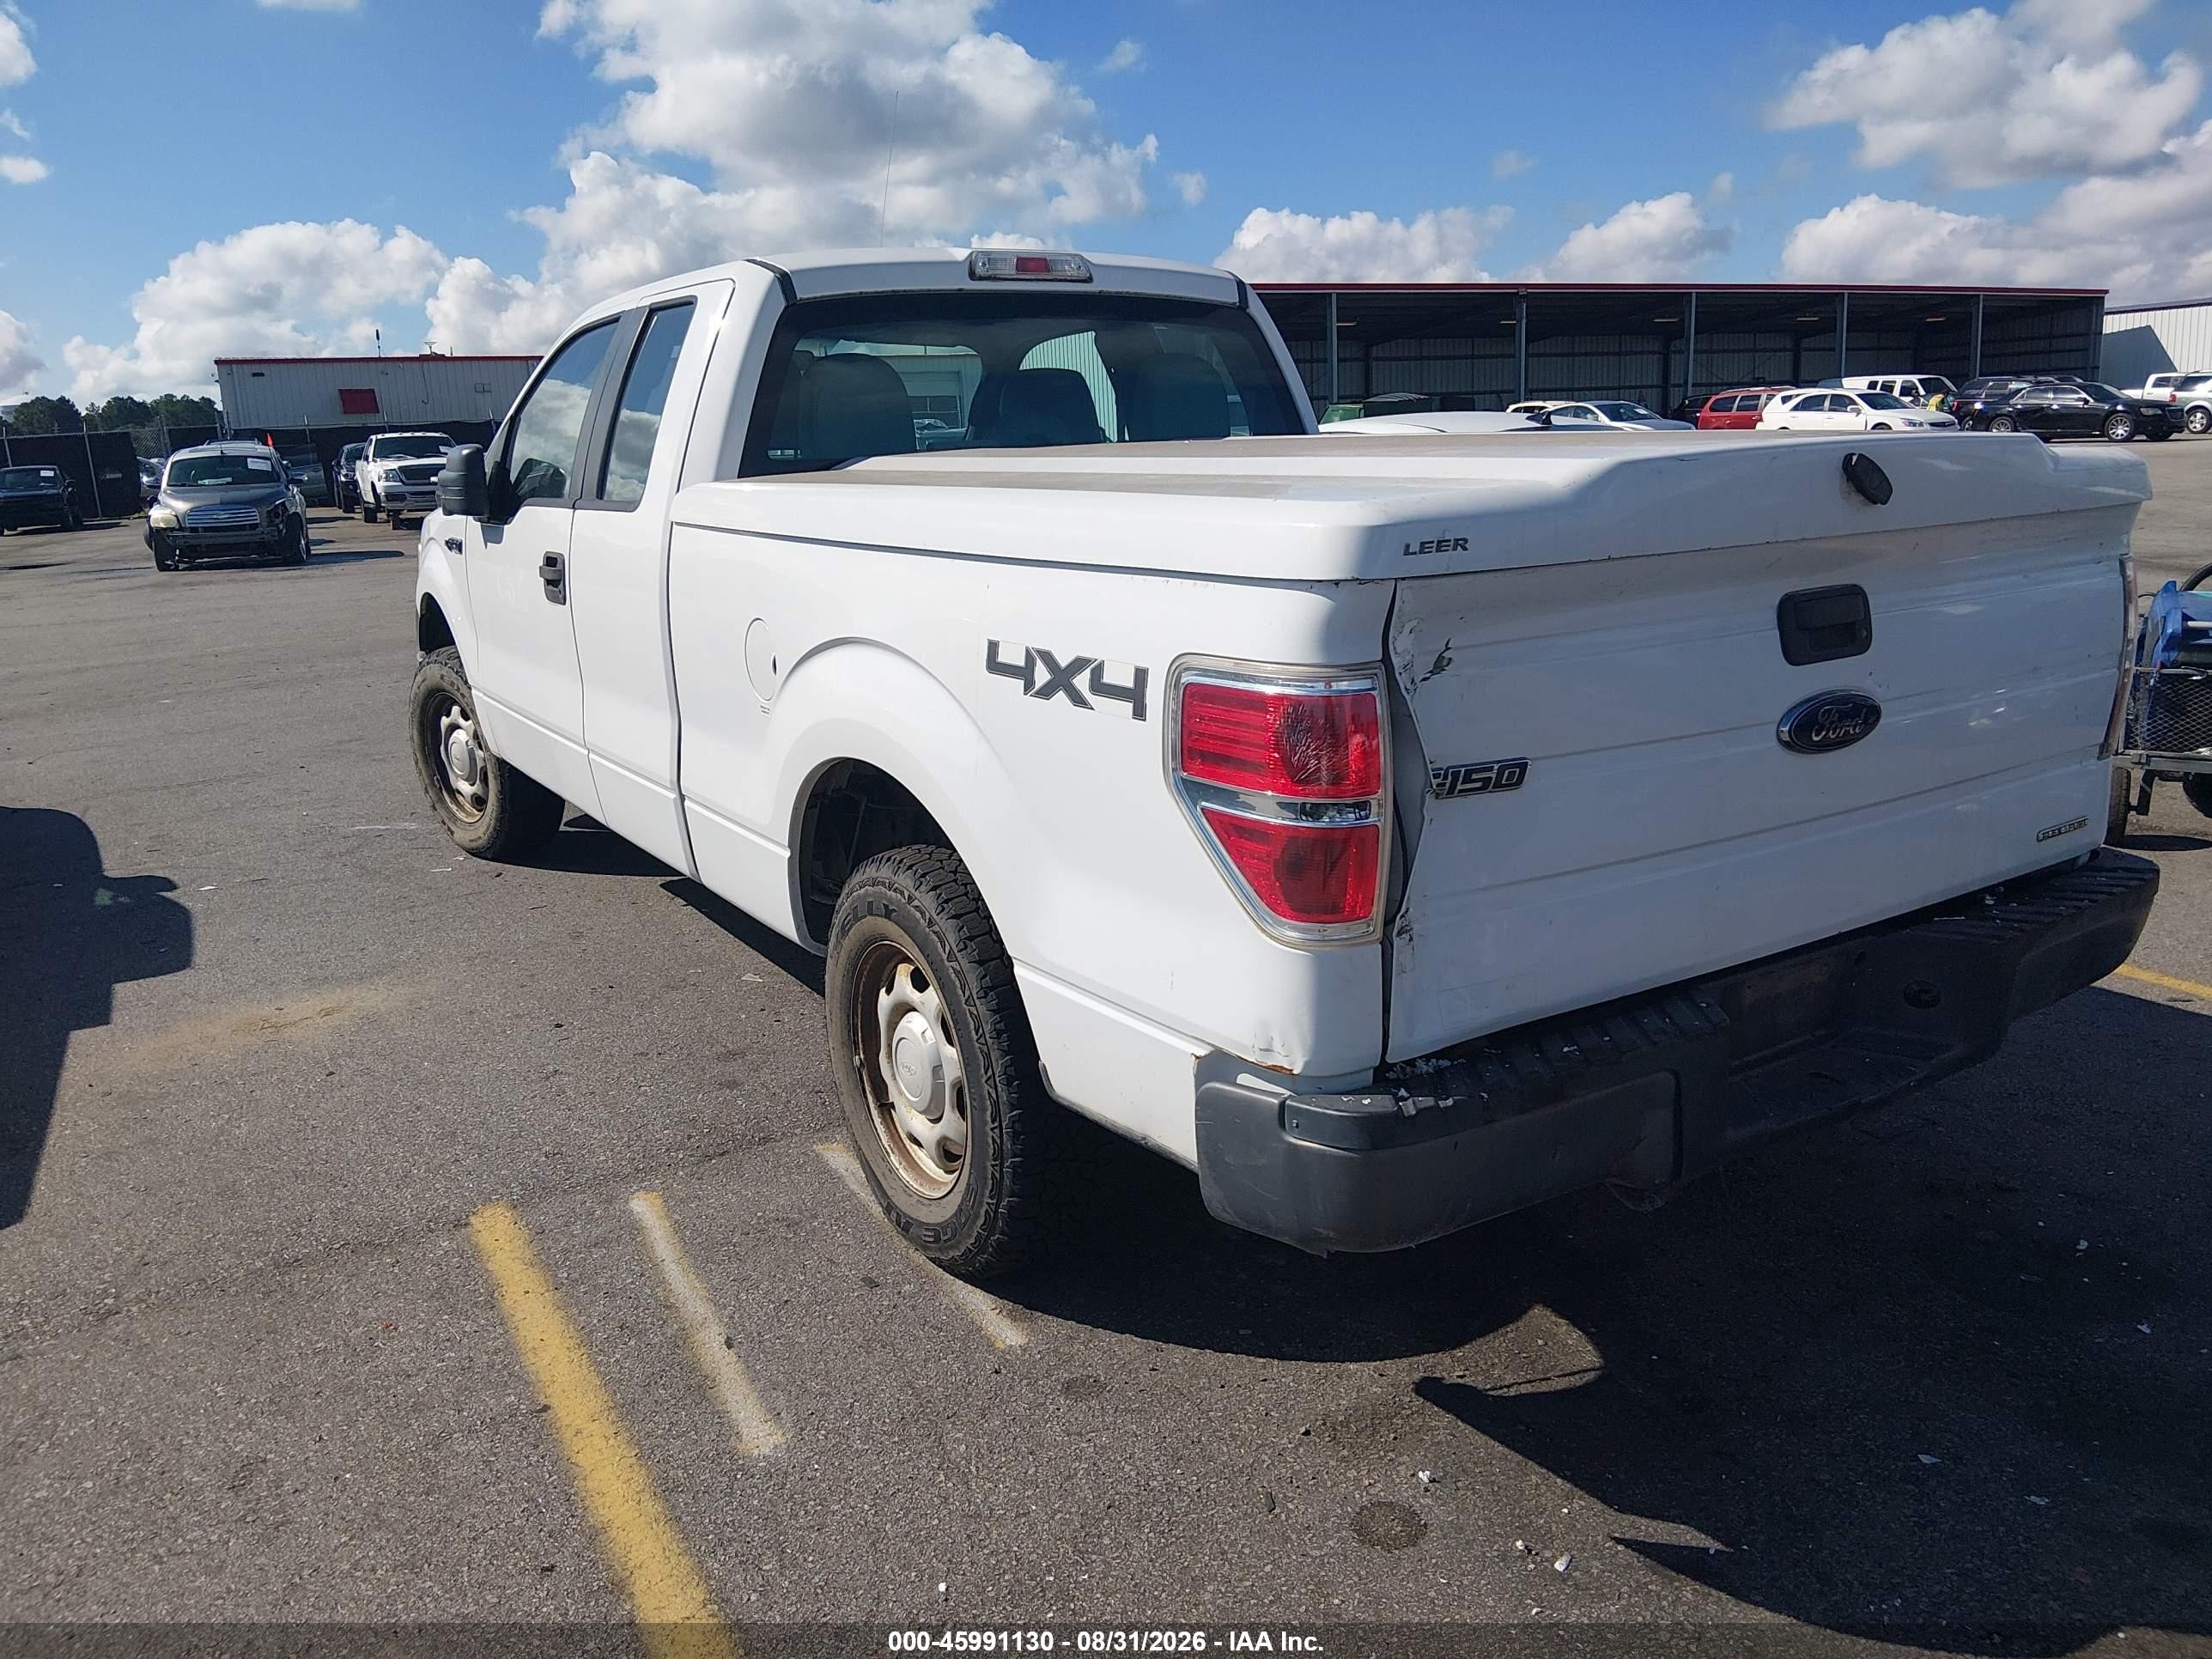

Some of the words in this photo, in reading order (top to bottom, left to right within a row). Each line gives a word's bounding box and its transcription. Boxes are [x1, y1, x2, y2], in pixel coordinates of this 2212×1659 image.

[1402, 537, 1469, 556] LEER
[986, 638, 1149, 722] 4X4
[1811, 702, 1869, 742] Ford
